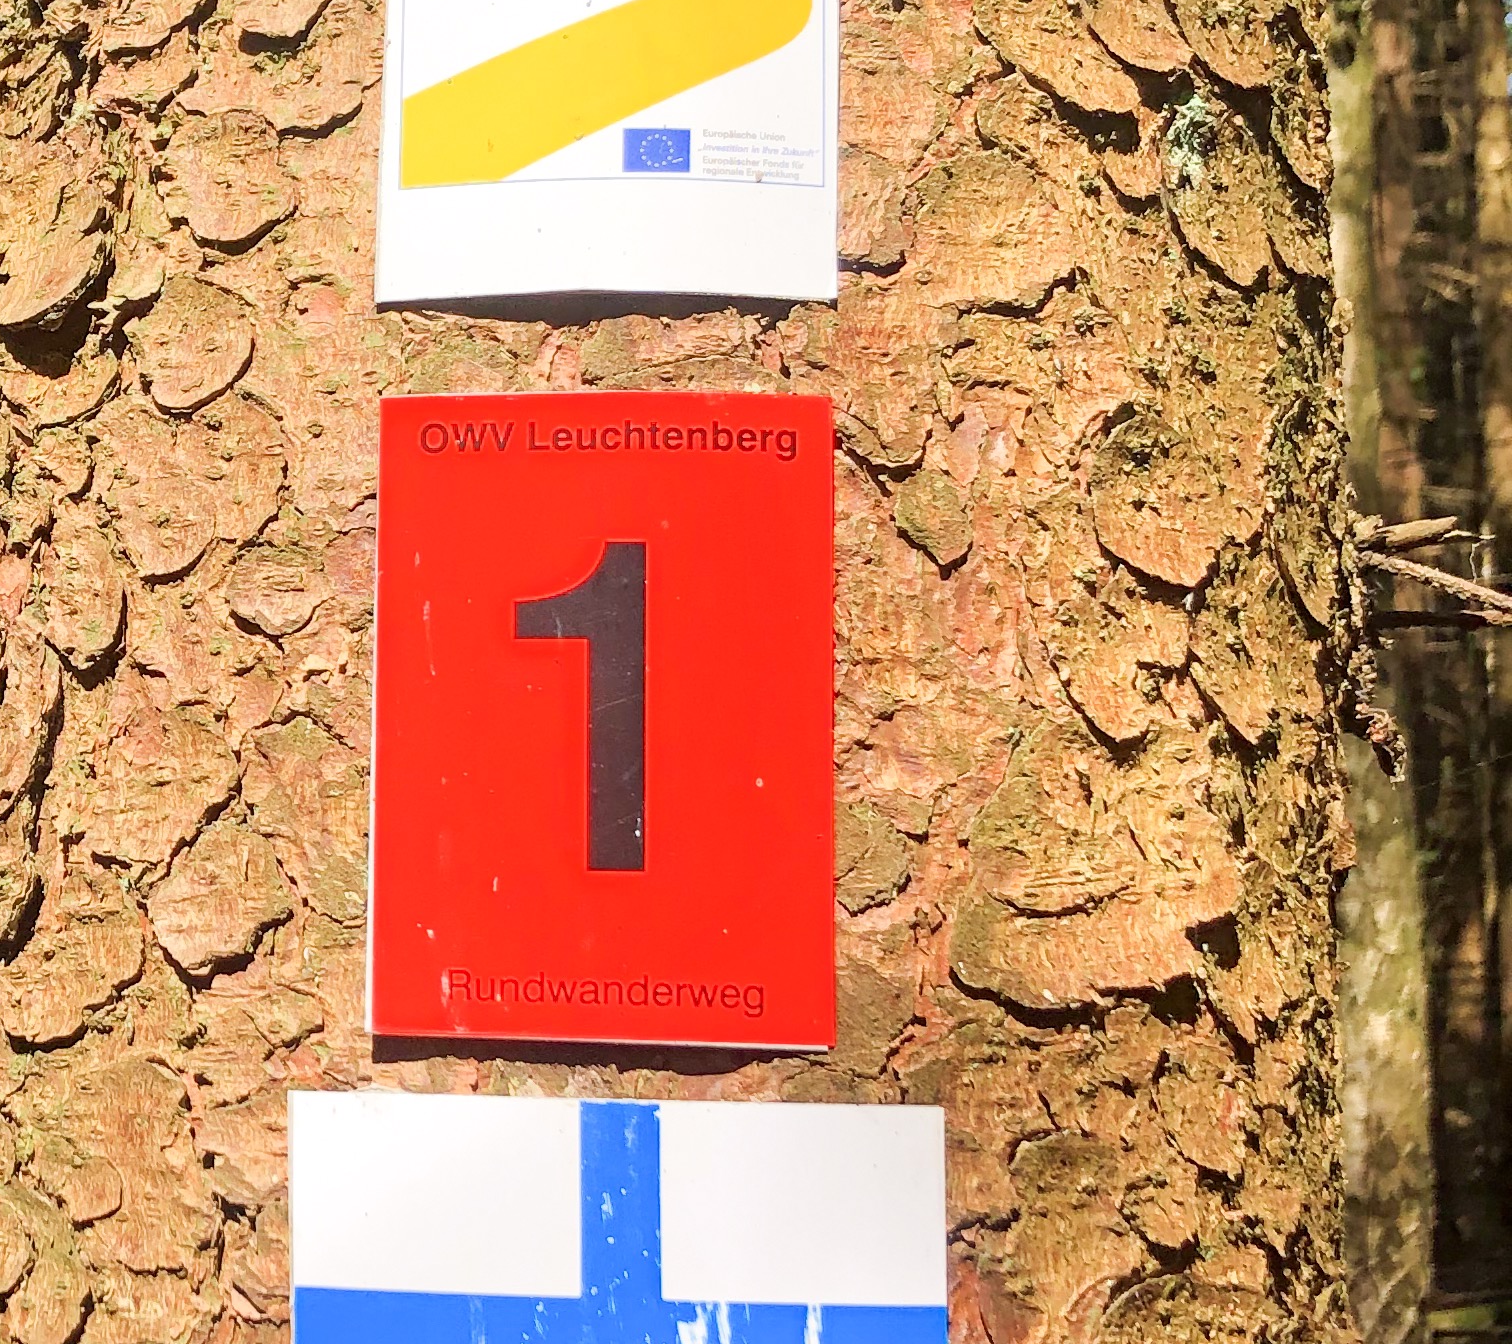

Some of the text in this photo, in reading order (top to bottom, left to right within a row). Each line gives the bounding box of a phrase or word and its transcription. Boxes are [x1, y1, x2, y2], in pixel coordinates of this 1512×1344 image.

[702, 128, 786, 142] Europäische Union
[751, 145, 760, 154] in
[762, 146, 779, 155] Ihre
[702, 156, 804, 170] Europäischer Fonds für
[702, 166, 745, 177] regionale
[420, 420, 798, 461] OWV Leuchtenberg
[514, 541, 646, 872] 1
[448, 969, 765, 1017] Rundwanderweg
